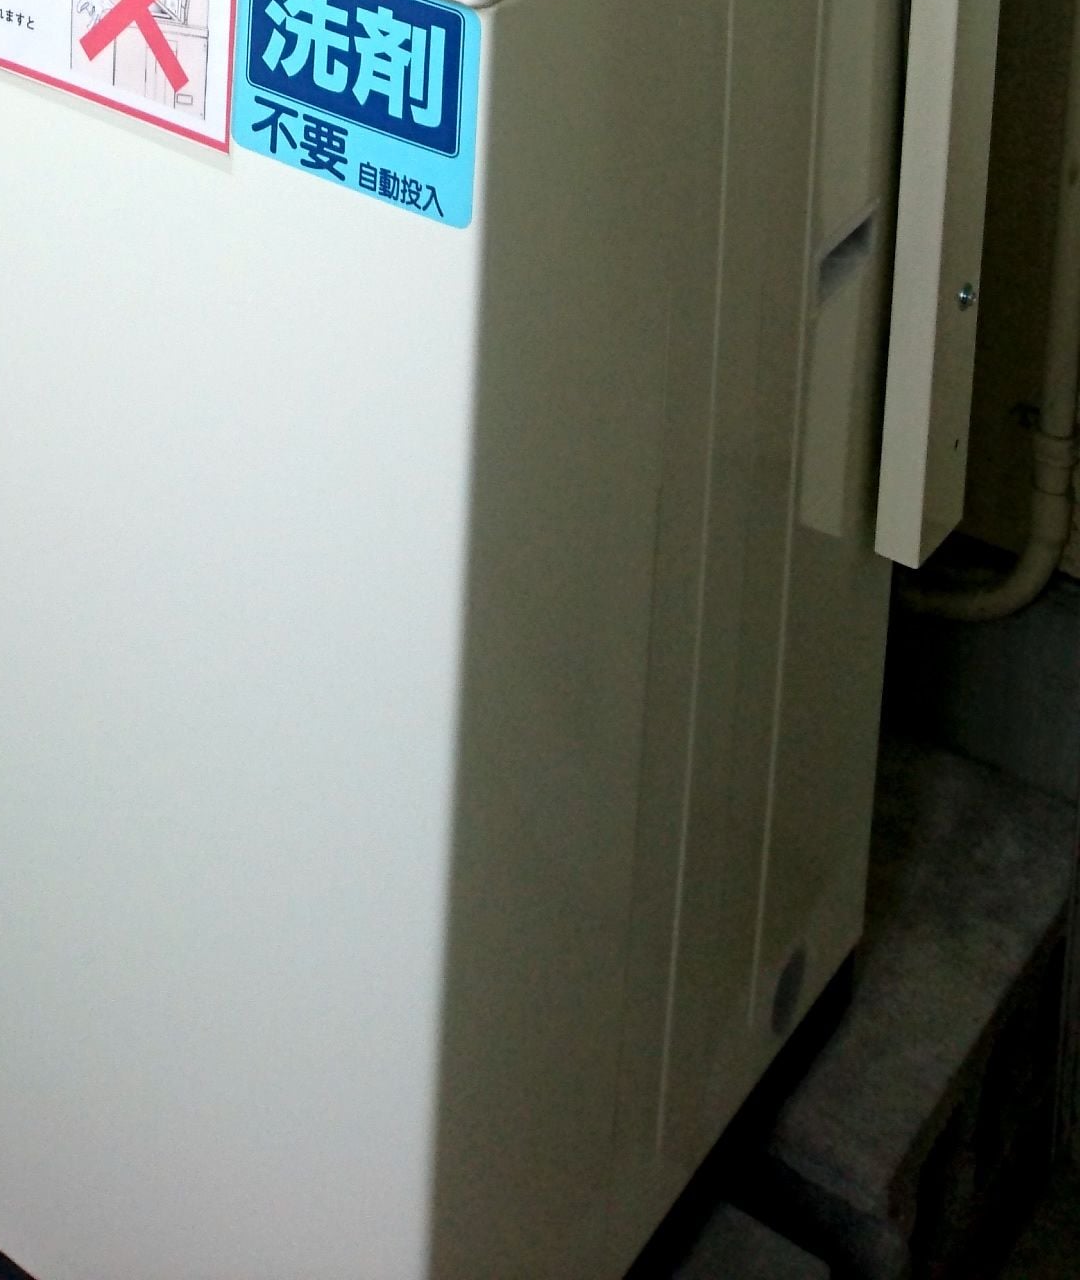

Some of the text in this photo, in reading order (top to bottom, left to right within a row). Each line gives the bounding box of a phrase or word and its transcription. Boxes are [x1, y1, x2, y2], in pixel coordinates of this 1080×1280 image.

[252, 96, 348, 181] 不要
[359, 161, 444, 218] 自動投入
